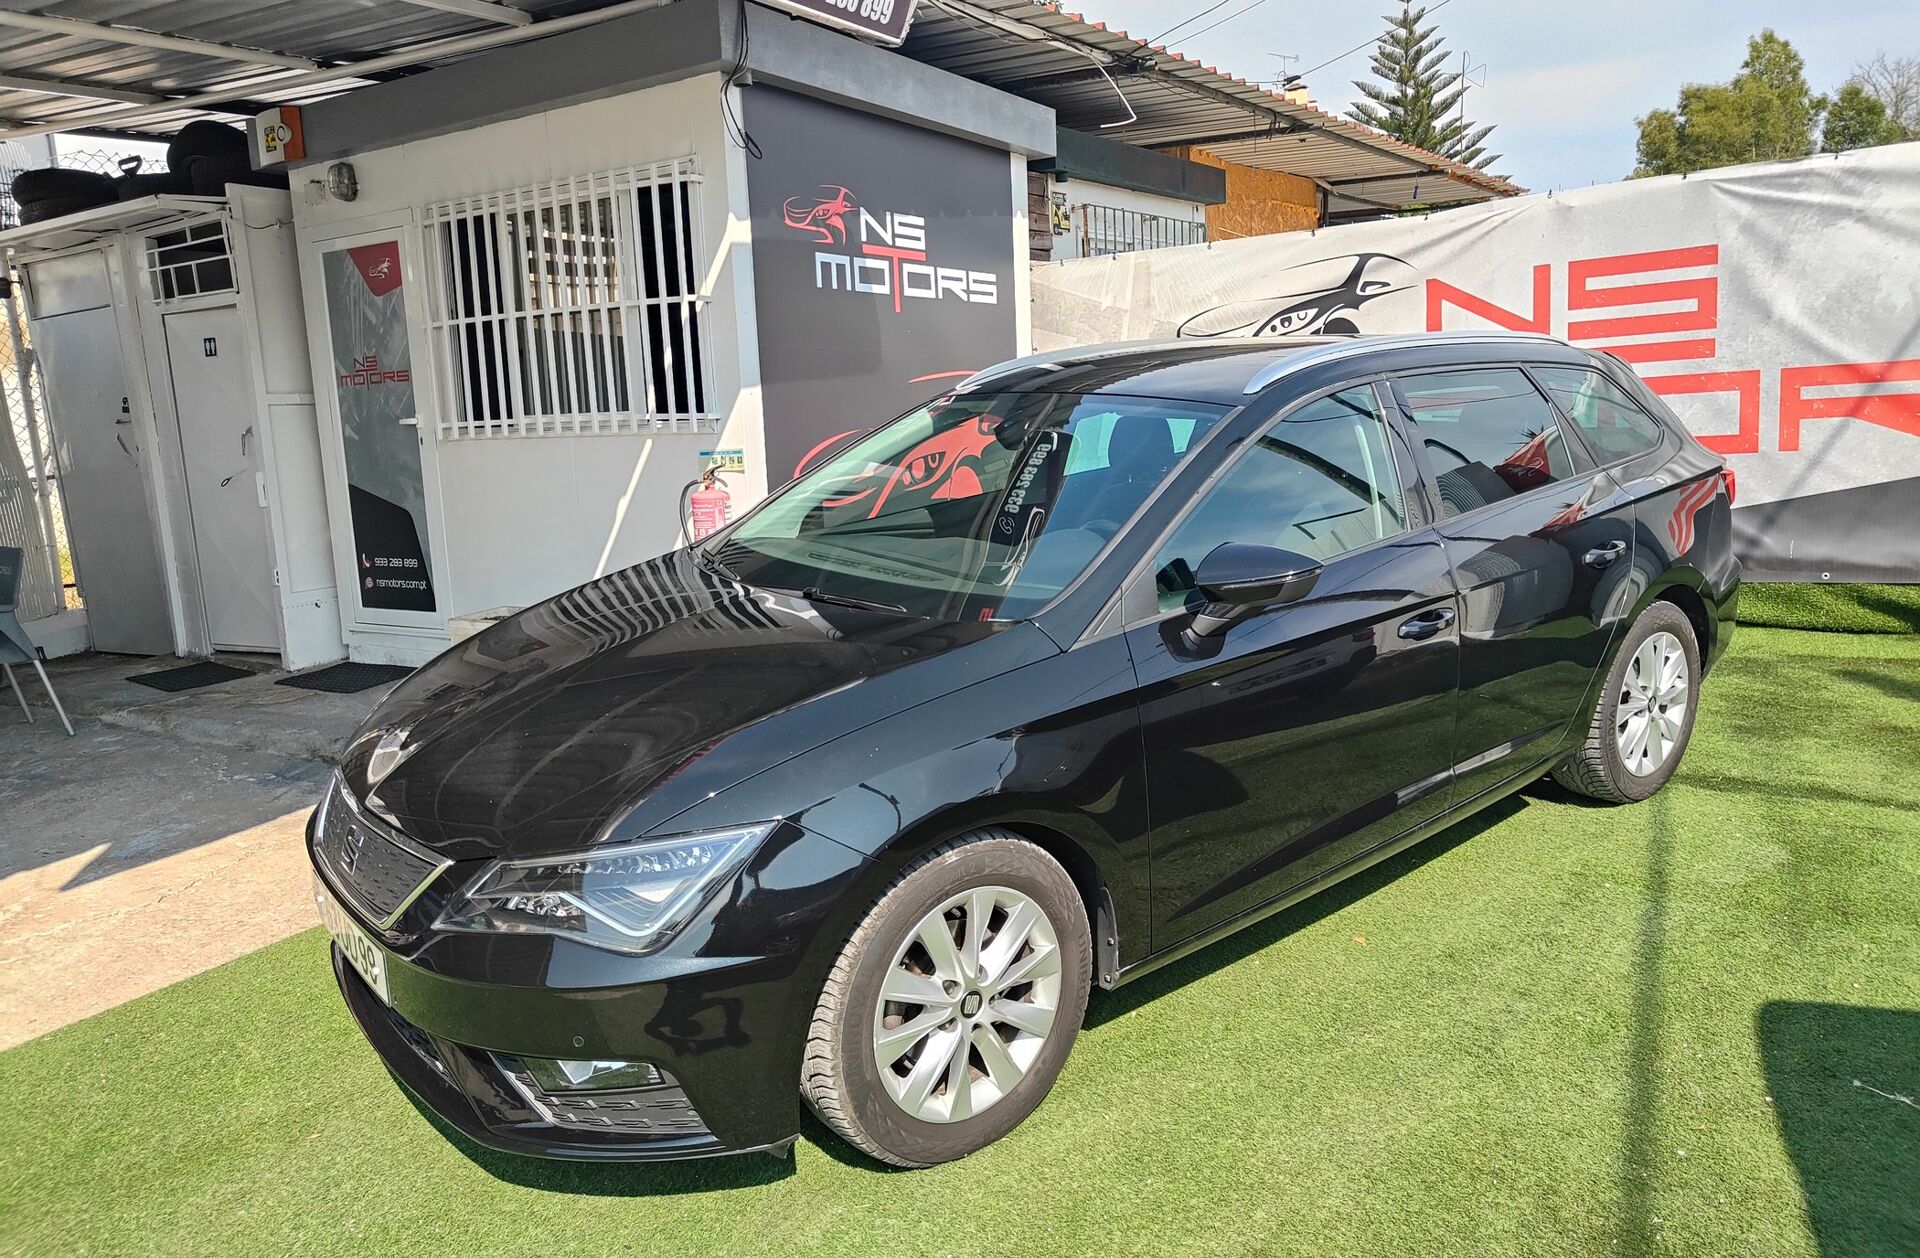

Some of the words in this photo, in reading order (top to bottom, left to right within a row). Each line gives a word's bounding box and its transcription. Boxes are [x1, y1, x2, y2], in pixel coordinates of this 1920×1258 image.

[859, 206, 926, 250] NS
[815, 244, 998, 313] MOTORS
[1426, 244, 1719, 342] NS
[340, 367, 411, 391] MOTORS
[353, 355, 378, 369] NS
[374, 557, 388, 567] 933
[389, 558, 403, 567] 283
[403, 558, 418, 568] 899
